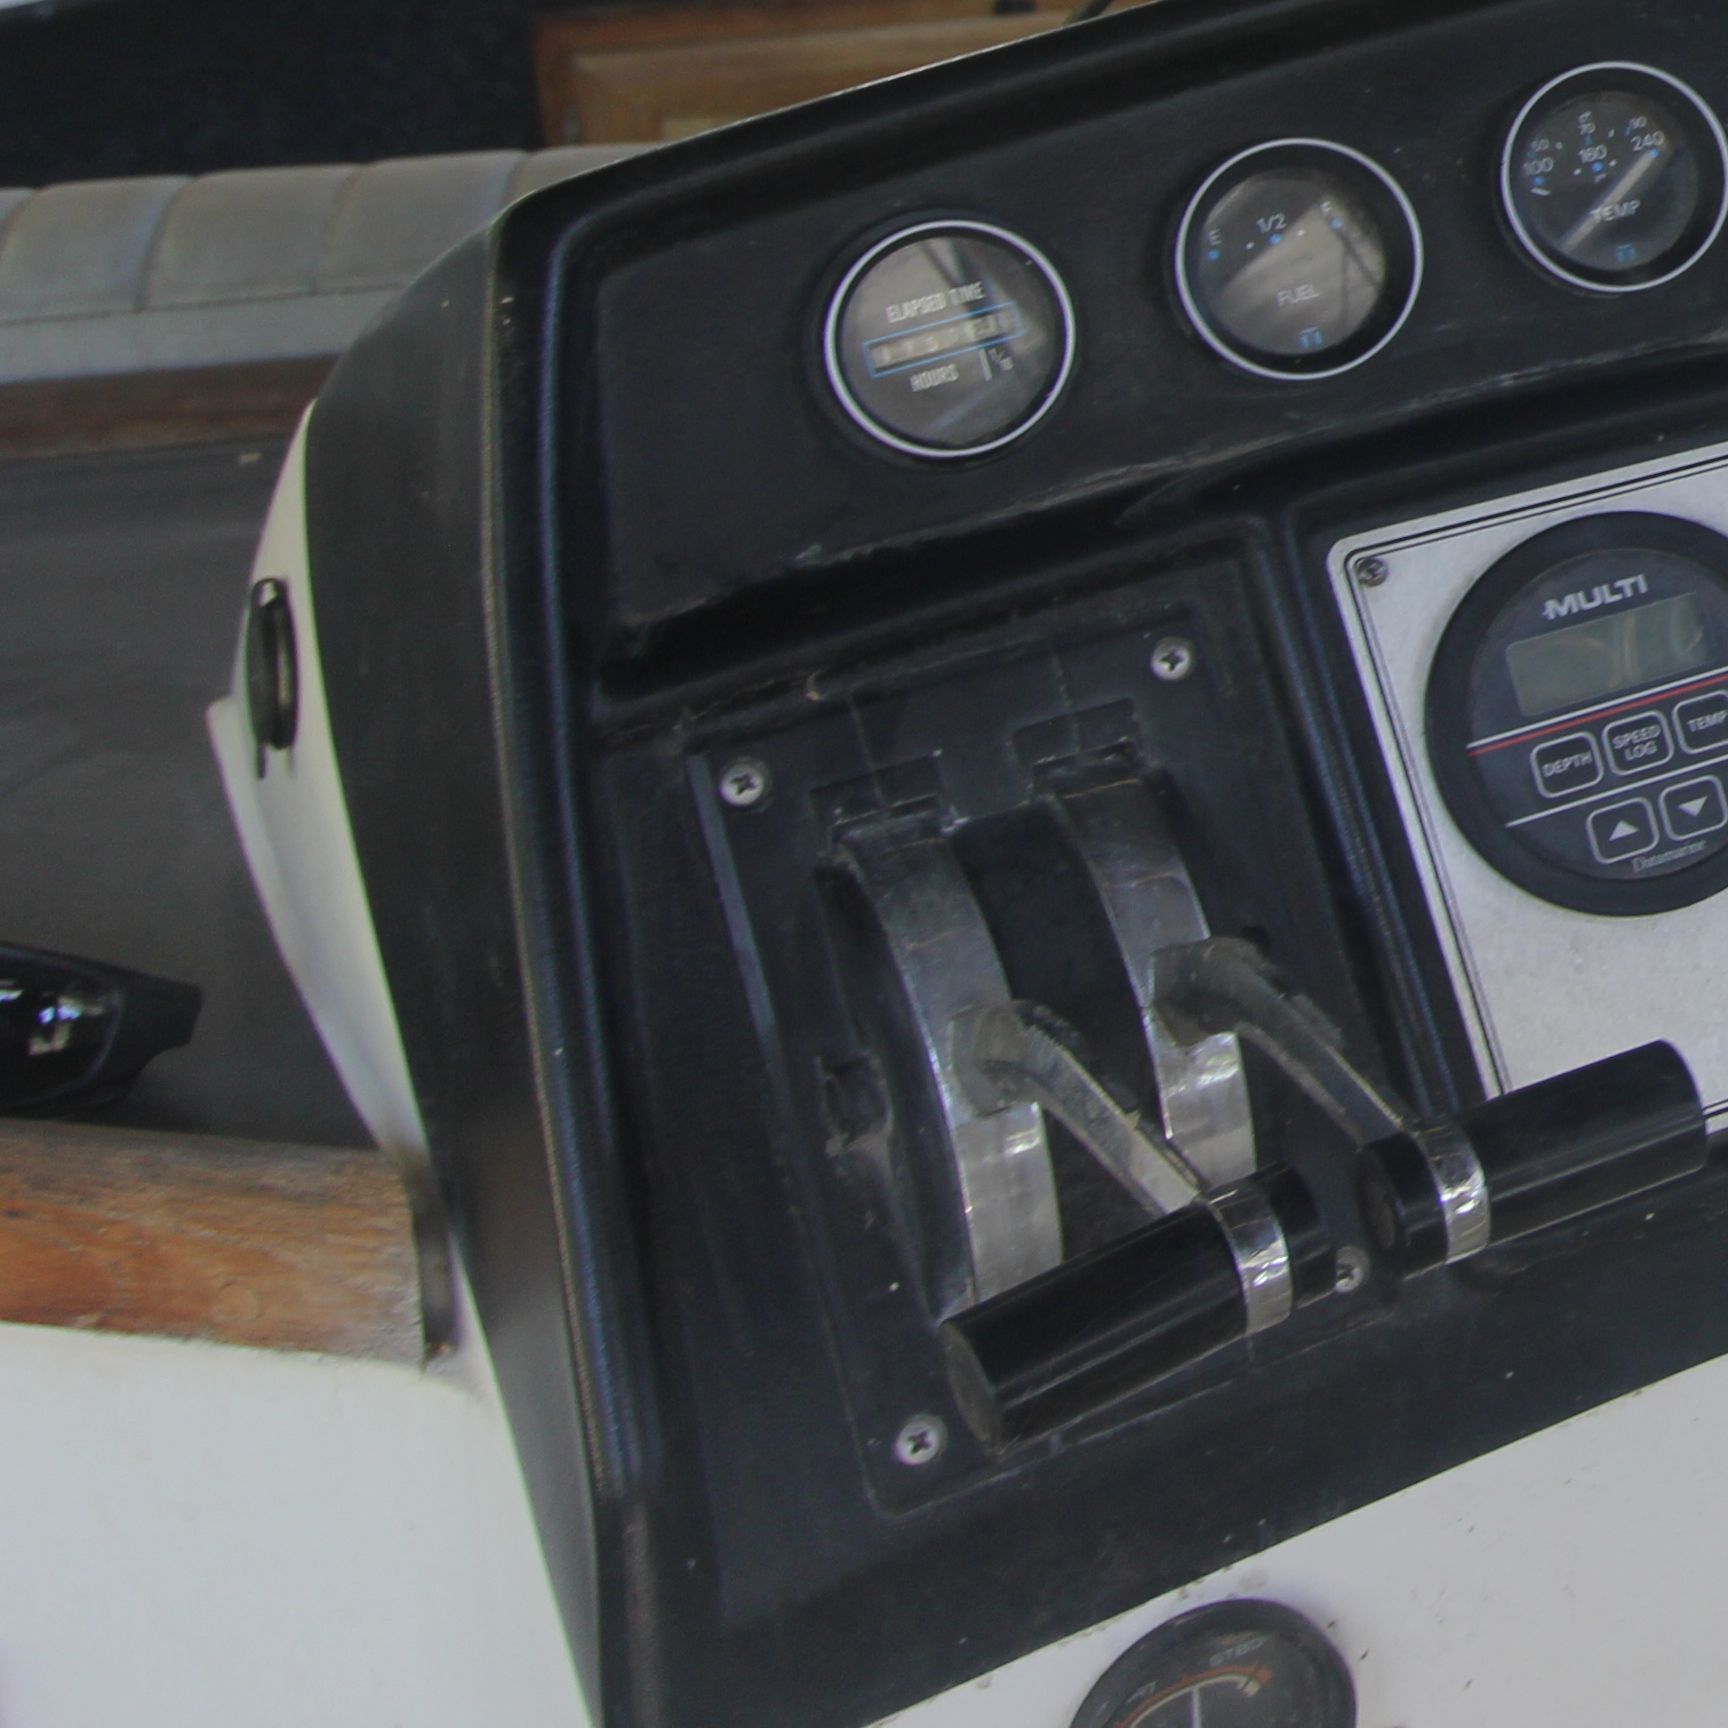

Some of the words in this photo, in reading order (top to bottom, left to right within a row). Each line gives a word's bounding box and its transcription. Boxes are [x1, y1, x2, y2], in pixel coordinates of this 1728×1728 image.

[1277, 284, 1321, 307] FUEL
[1543, 573, 1649, 621] MULTI
[1687, 709, 1728, 732] TEMP
[1611, 724, 1661, 750] SPEED
[1623, 740, 1658, 761] LOG
[1541, 752, 1593, 777] DEPTH
